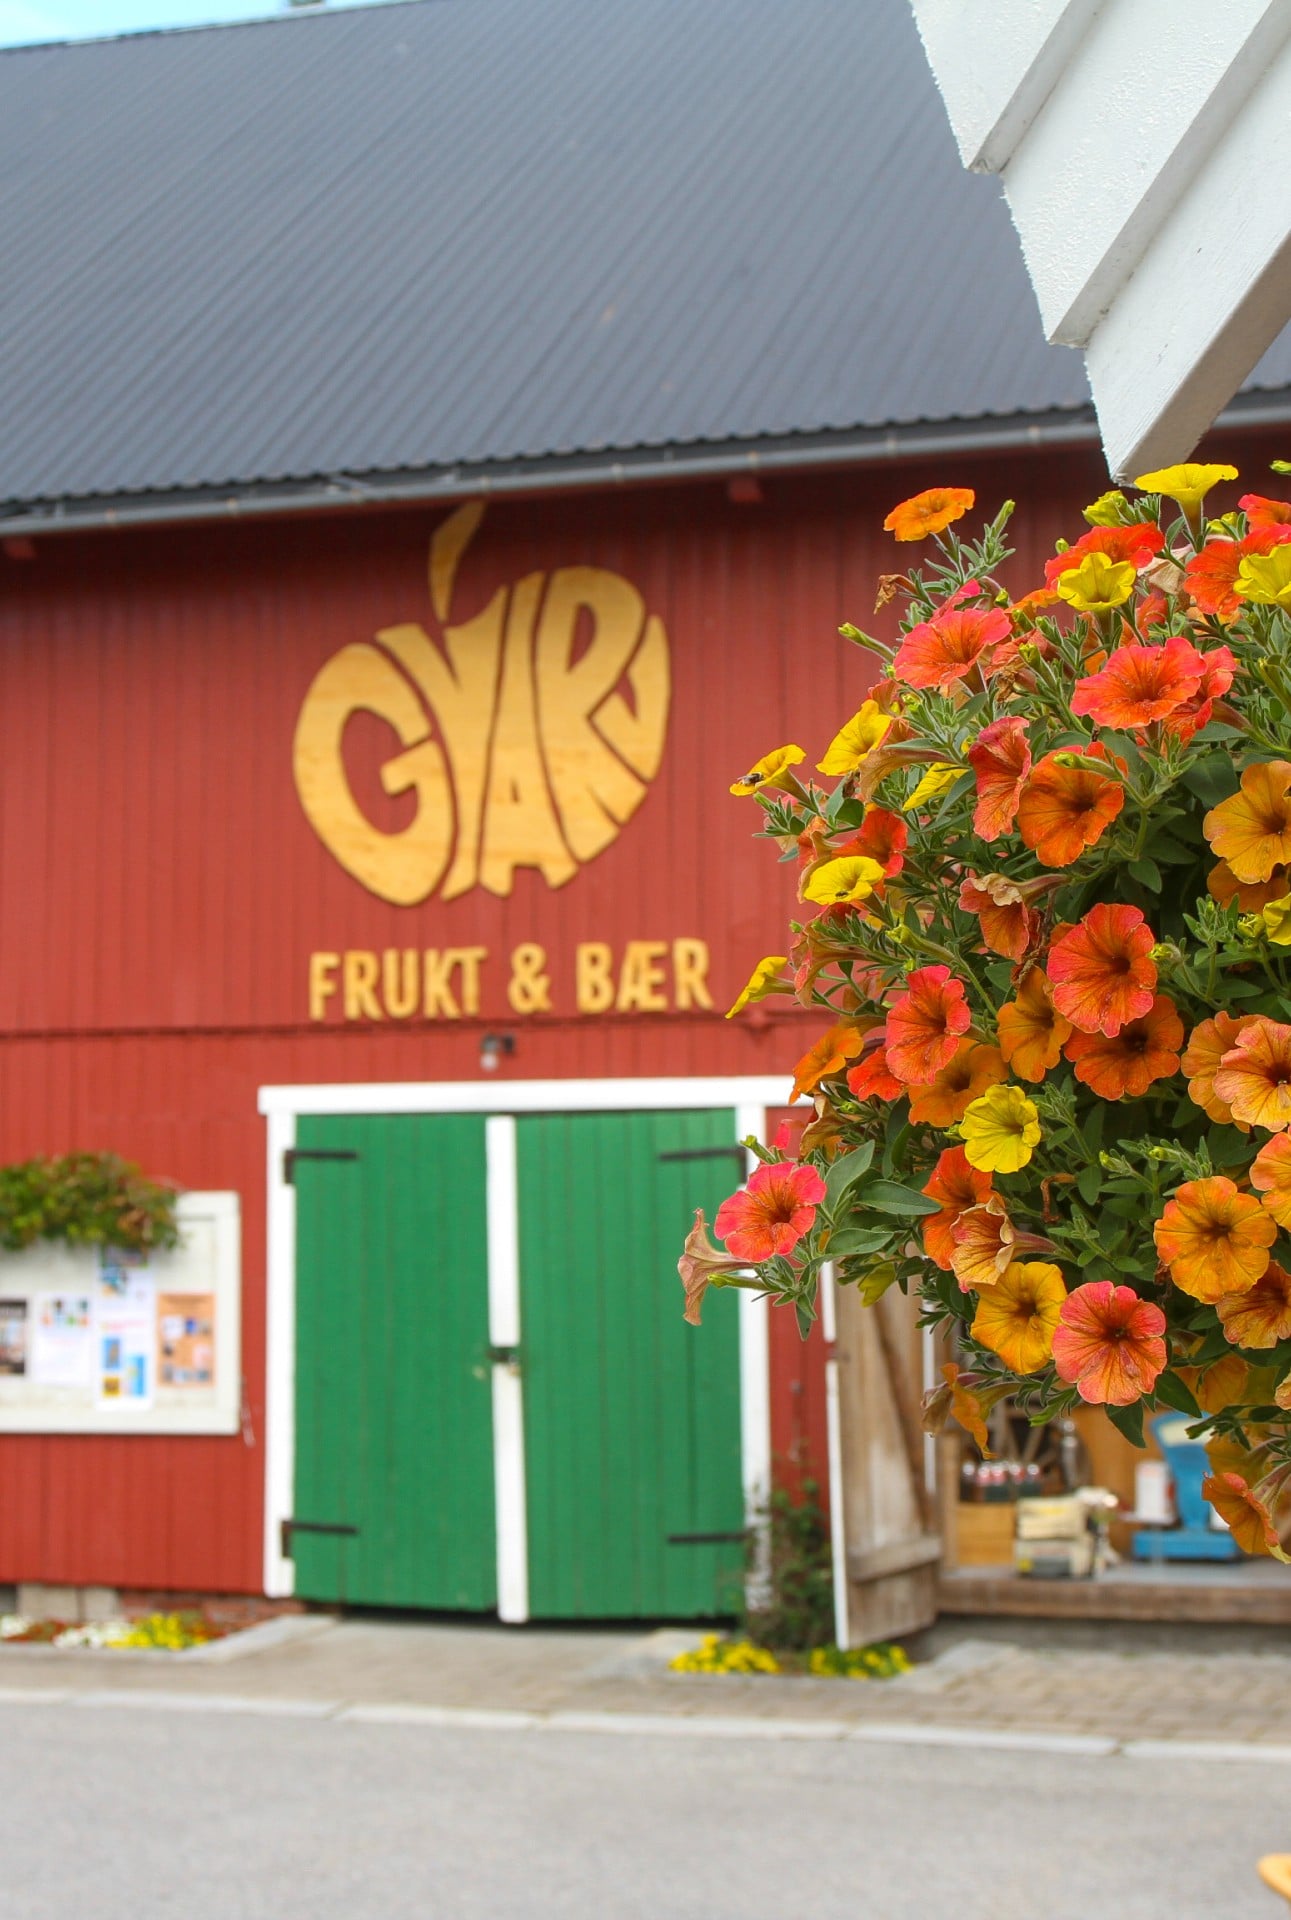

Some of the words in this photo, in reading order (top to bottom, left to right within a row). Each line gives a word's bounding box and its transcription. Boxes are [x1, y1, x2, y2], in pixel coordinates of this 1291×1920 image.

[308, 947, 488, 1021] FRUKT
[508, 943, 552, 1014] &
[575, 938, 713, 1014] BÆR
